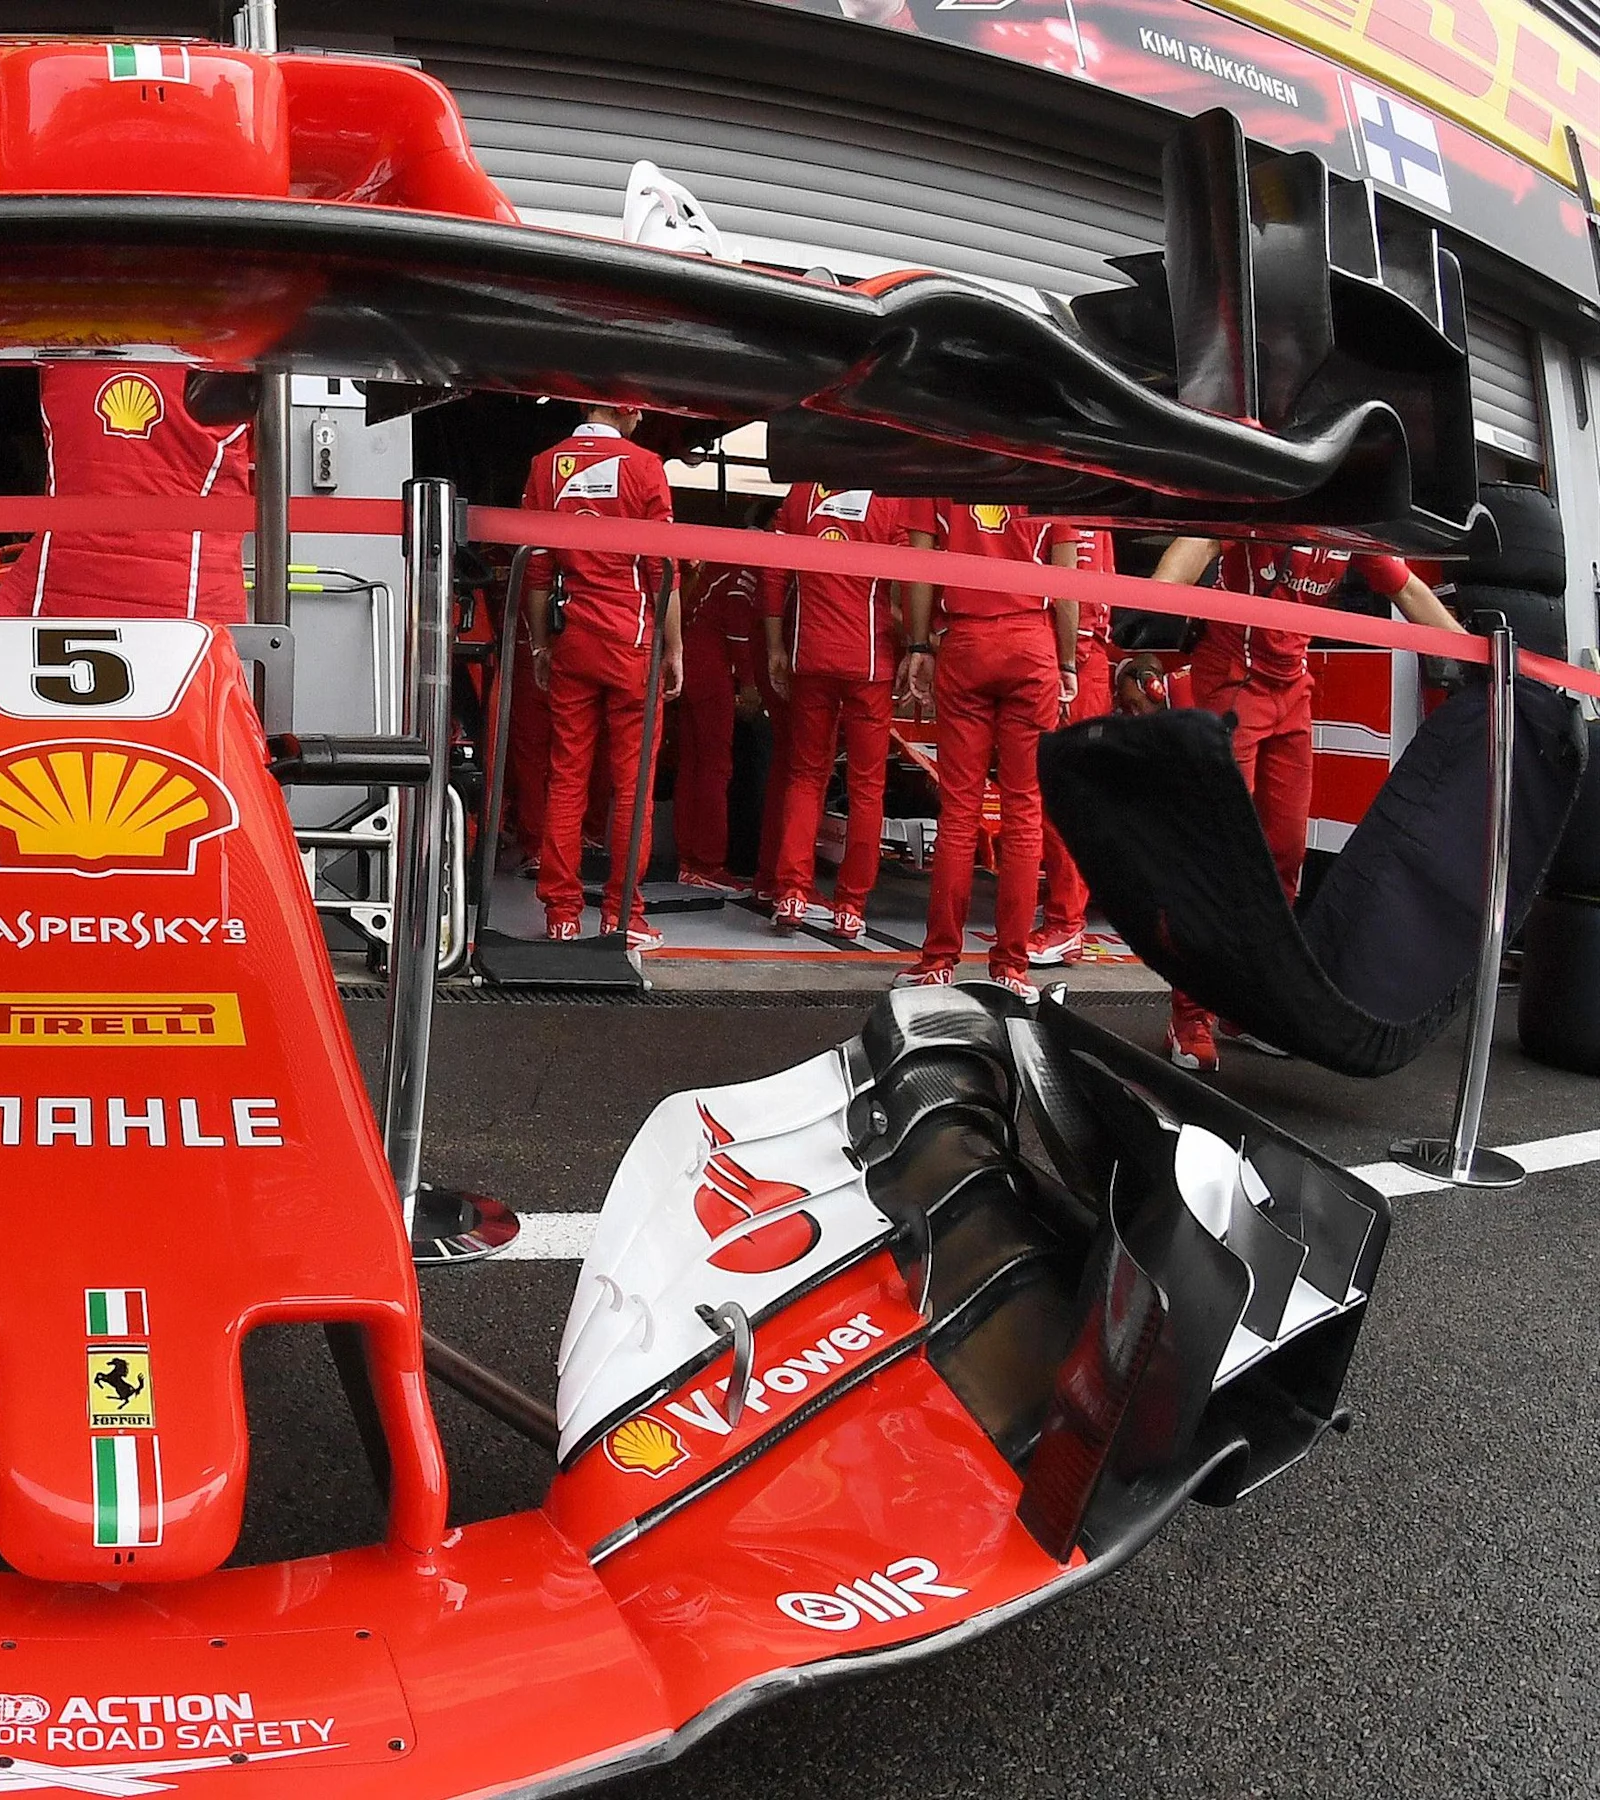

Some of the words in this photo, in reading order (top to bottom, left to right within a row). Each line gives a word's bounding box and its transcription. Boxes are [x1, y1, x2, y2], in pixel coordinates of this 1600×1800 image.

[1138, 27, 1187, 64] KIMI
[1188, 45, 1299, 108] RÄIKKÖNEN
[30, 626, 135, 709] 5
[92, 1414, 151, 1426] Ferrari
[57, 1692, 255, 1725] ACTION
[46, 1725, 173, 1752] ROAD
[176, 1717, 336, 1750] SAFETY
